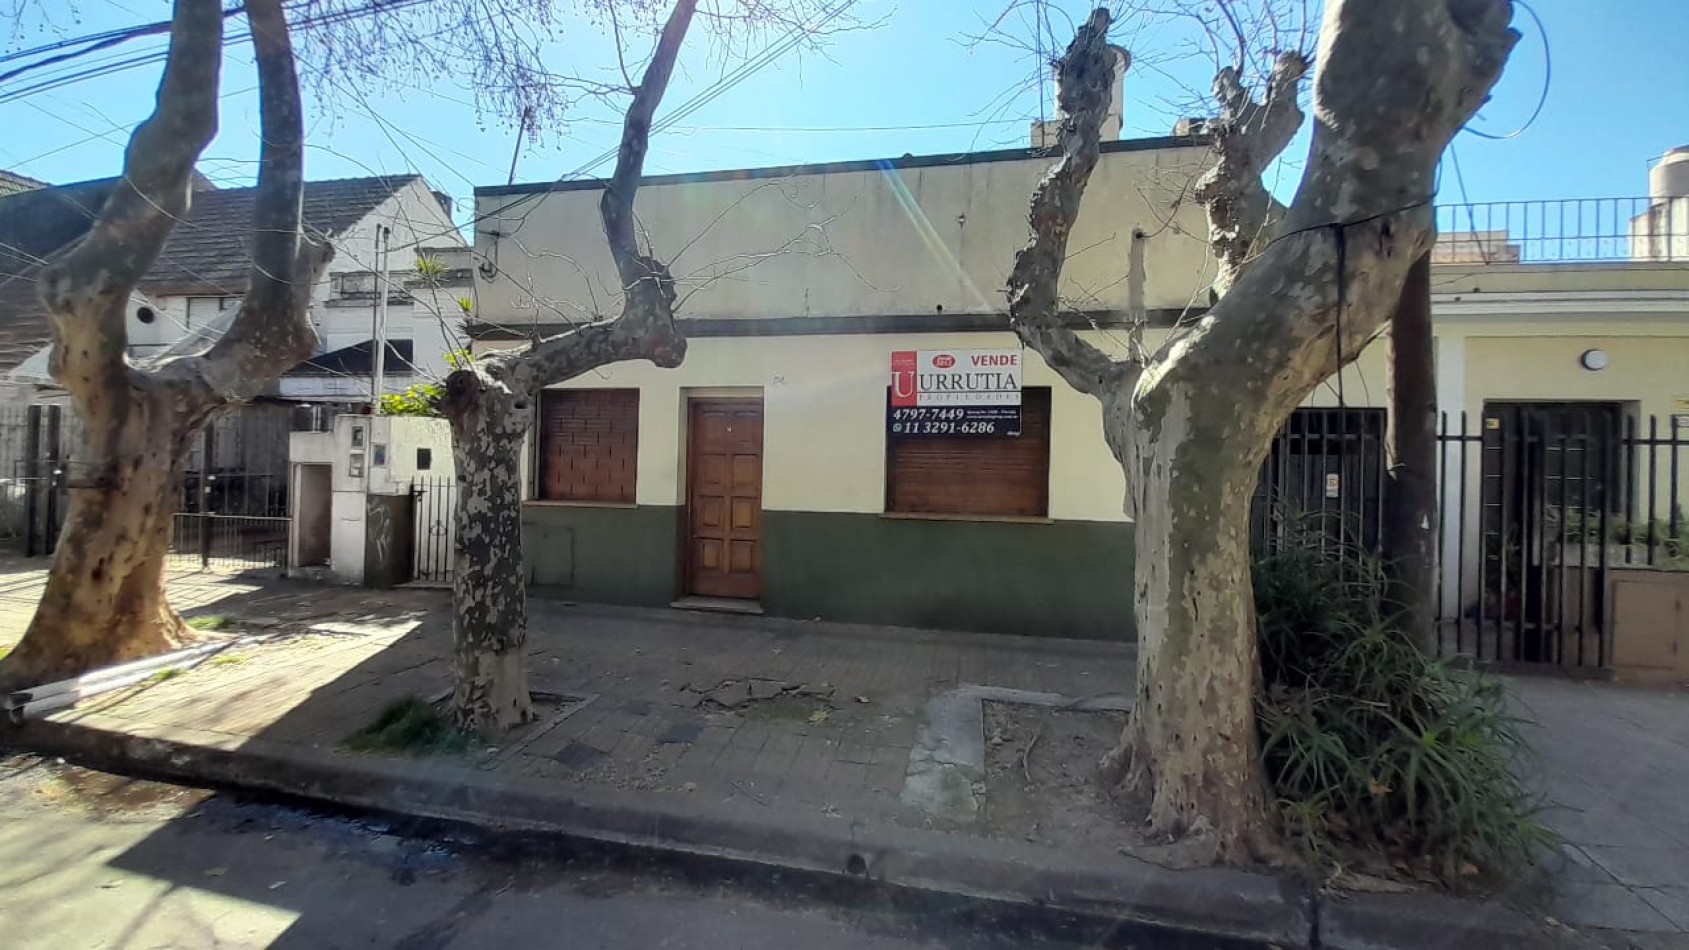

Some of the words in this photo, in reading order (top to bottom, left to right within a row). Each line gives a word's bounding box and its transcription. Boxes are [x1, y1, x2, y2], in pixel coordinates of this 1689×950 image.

[971, 355, 1018, 366] VENDE
[892, 371, 916, 398] U
[919, 373, 1017, 390] URRUTIA
[893, 408, 964, 420] 4797-7449
[905, 422, 919, 434] 11
[923, 422, 995, 434] 3291-6286
